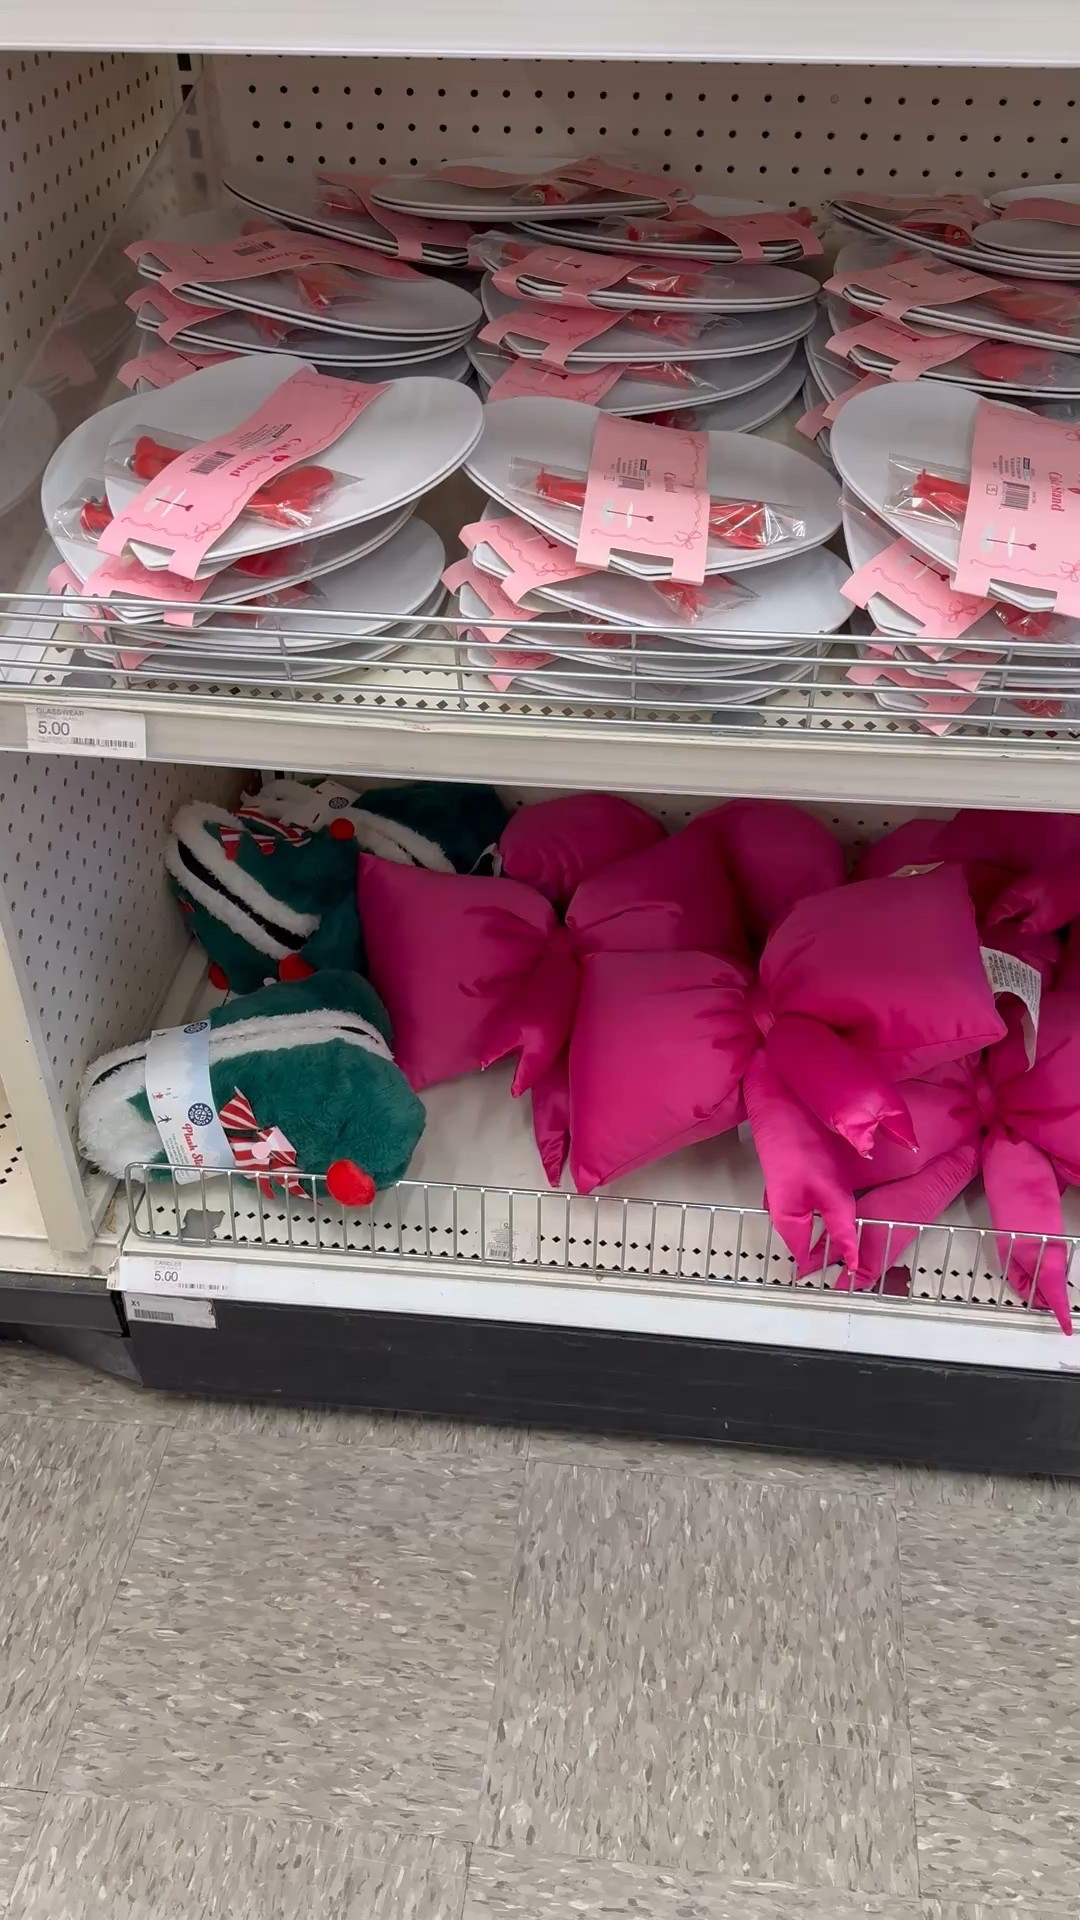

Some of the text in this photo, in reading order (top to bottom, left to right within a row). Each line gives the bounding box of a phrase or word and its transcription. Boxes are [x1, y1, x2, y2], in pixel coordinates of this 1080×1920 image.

[36, 707, 85, 717] GLASSWEAR
[38, 720, 70, 736] 5.00
[182, 1123, 198, 1151] Plush
[154, 1270, 178, 1282] 5.00
